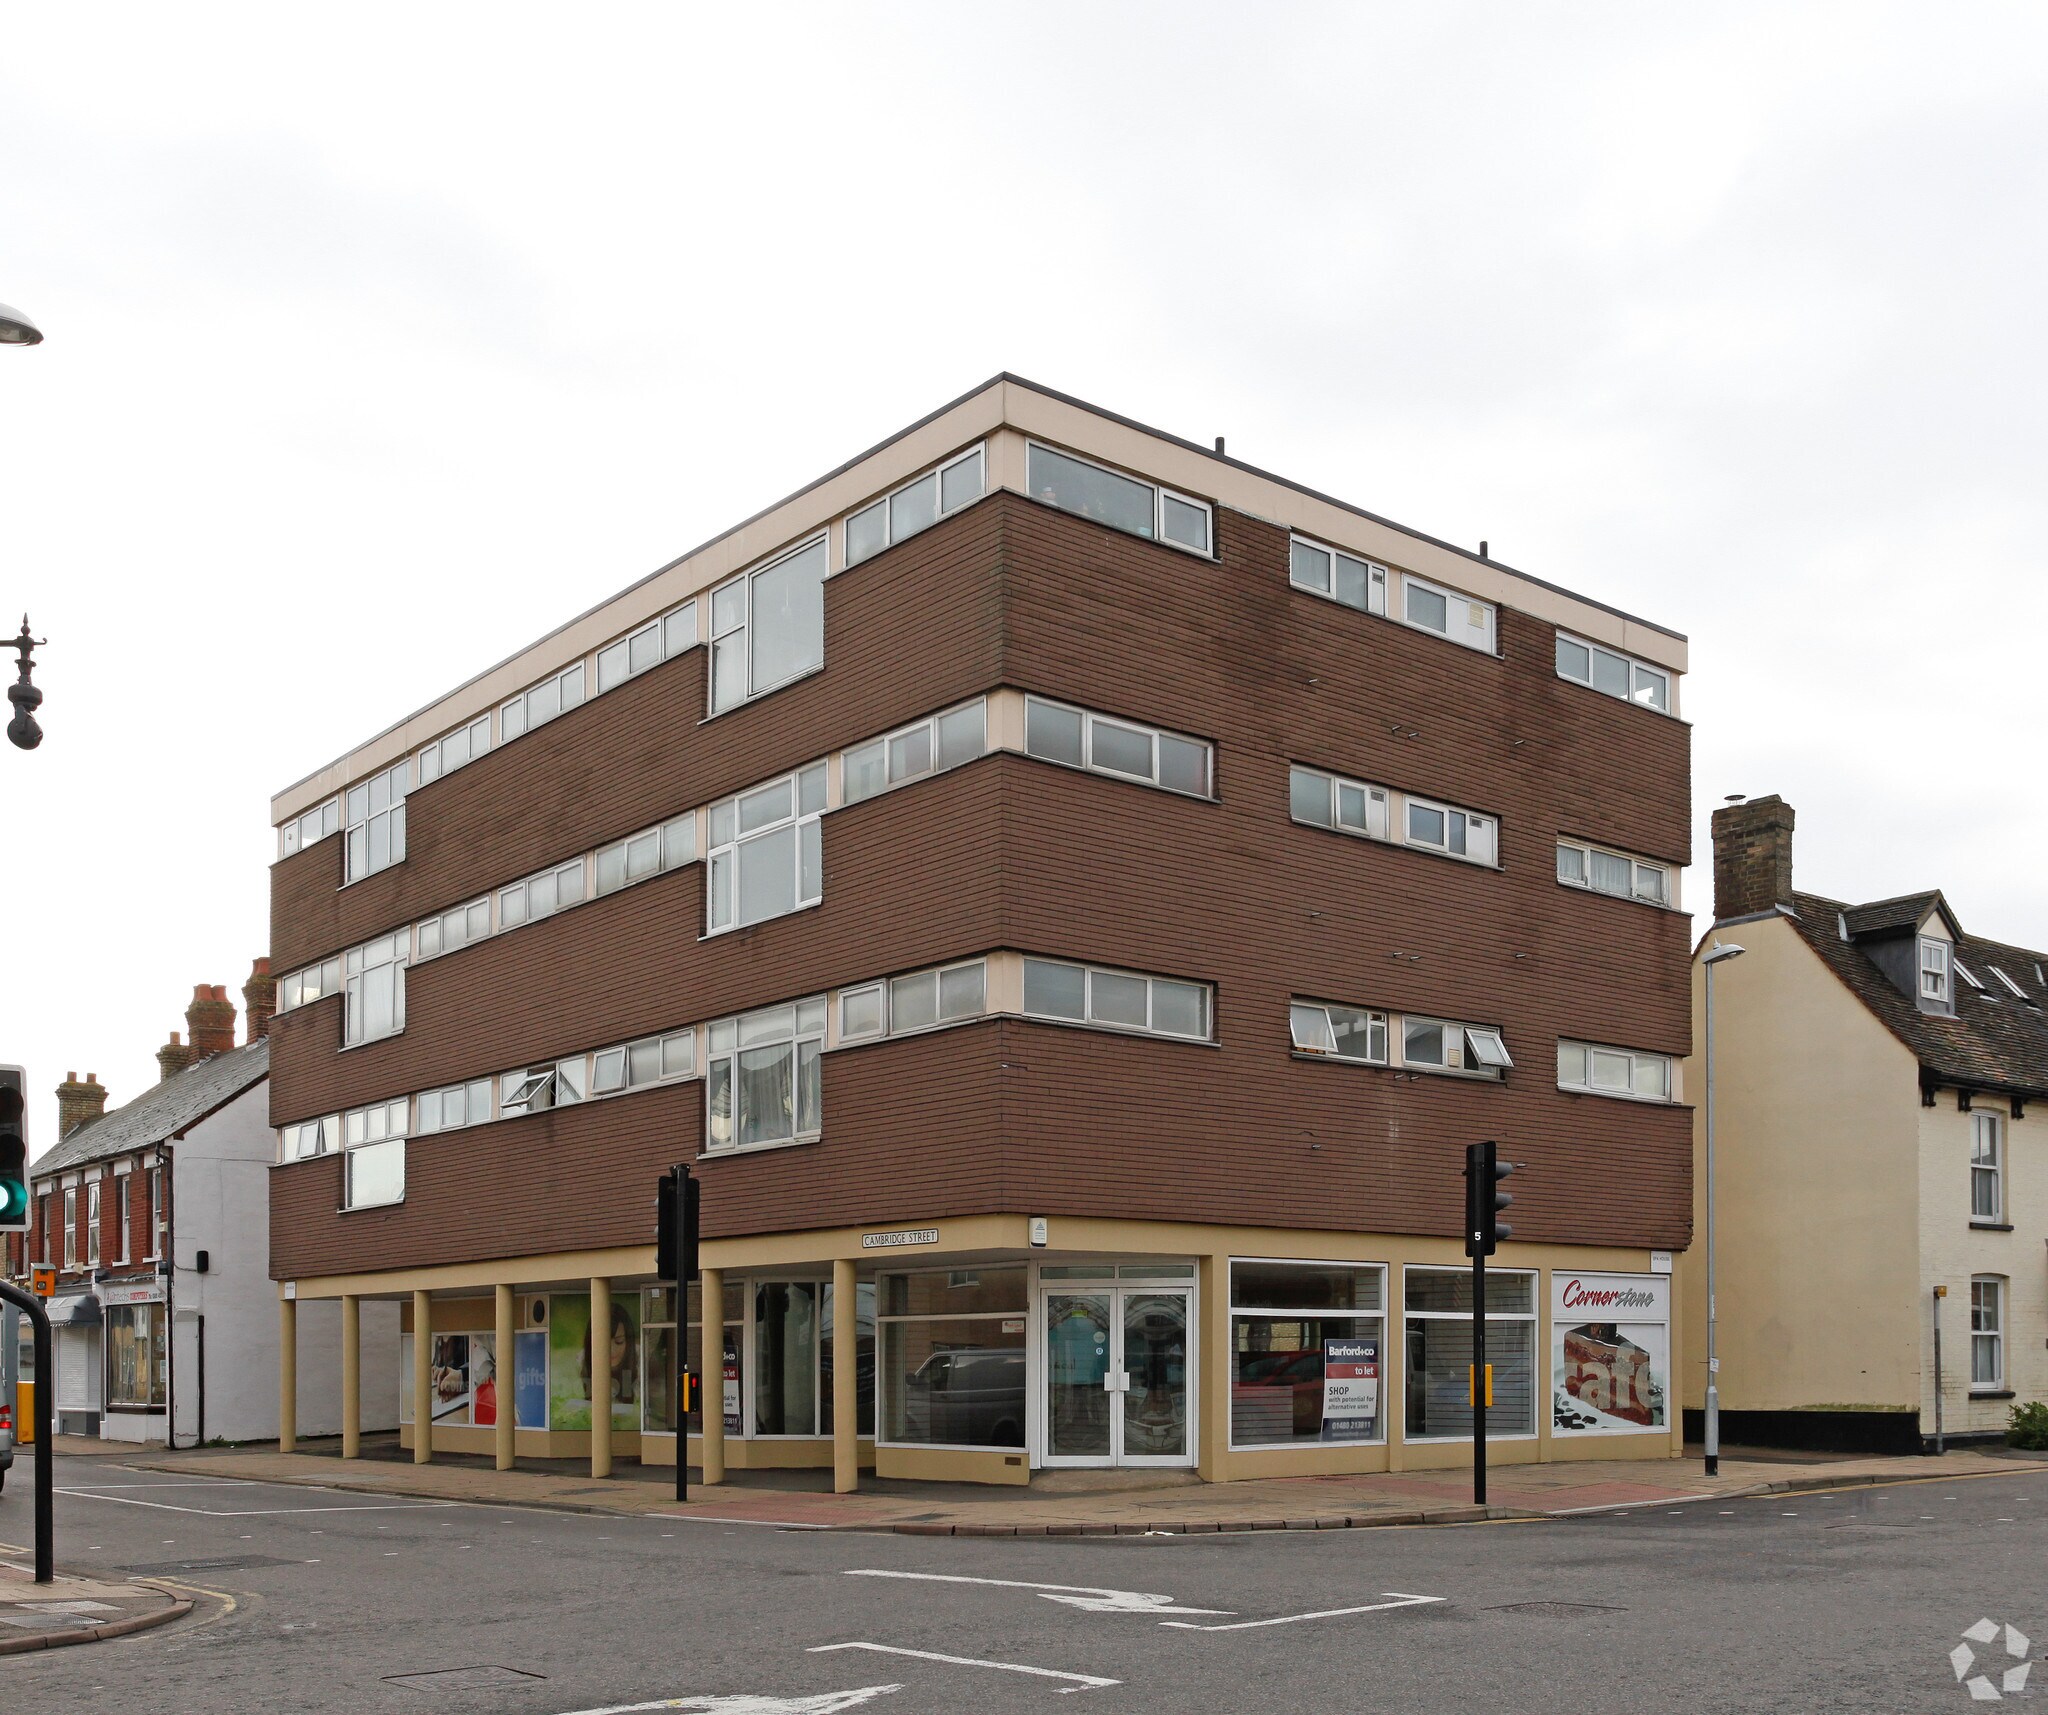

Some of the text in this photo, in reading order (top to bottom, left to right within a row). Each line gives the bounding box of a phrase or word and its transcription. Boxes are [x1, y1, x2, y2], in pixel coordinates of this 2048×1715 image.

[864, 1231, 936, 1246] CAMBRIDGE STREET
[1474, 1231, 1482, 1241] 5
[1562, 1279, 1655, 1308] Cornerstone
[1328, 1346, 1375, 1356] Barford+co
[1354, 1366, 1374, 1375] to let
[518, 1367, 545, 1390] gifts
[1328, 1386, 1350, 1396] SHOP
